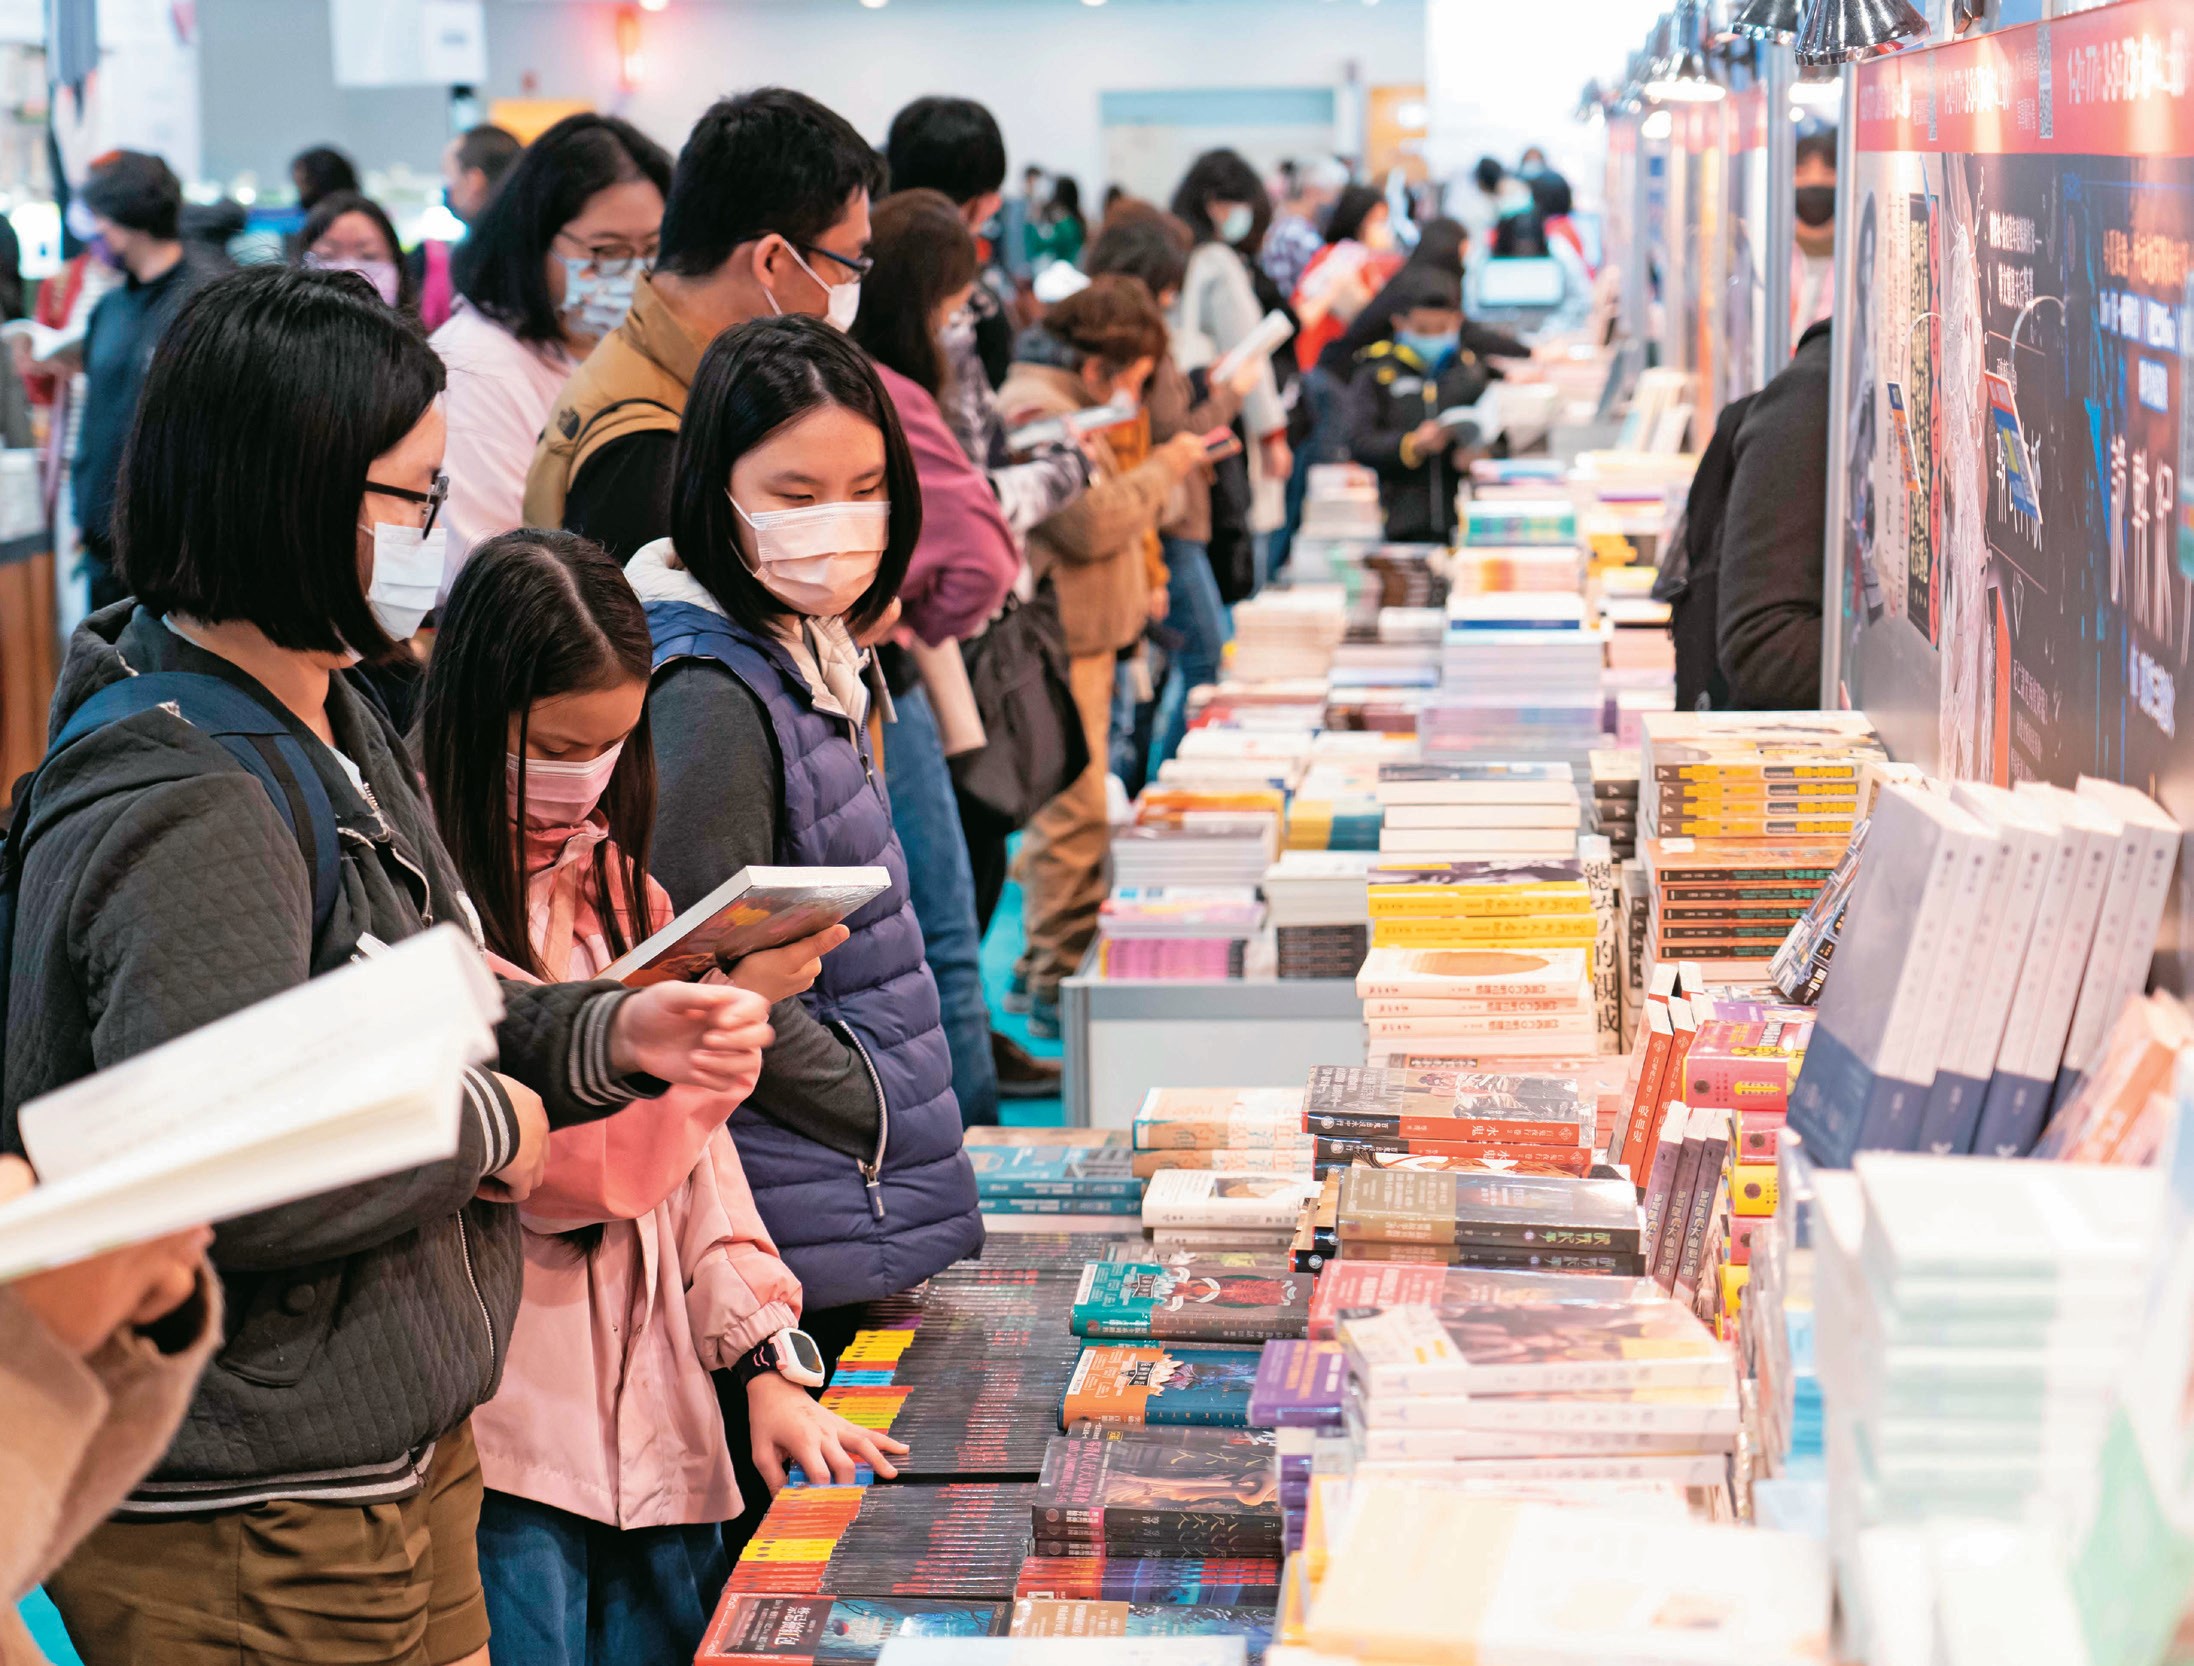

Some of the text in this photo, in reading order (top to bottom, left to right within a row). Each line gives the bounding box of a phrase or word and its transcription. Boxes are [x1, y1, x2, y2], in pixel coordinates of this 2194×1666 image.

[1471, 1124, 1499, 1137] 水鬼
[1632, 1105, 1650, 1142] 吸血鬼
[1177, 1513, 1240, 1532] 八尺大人
